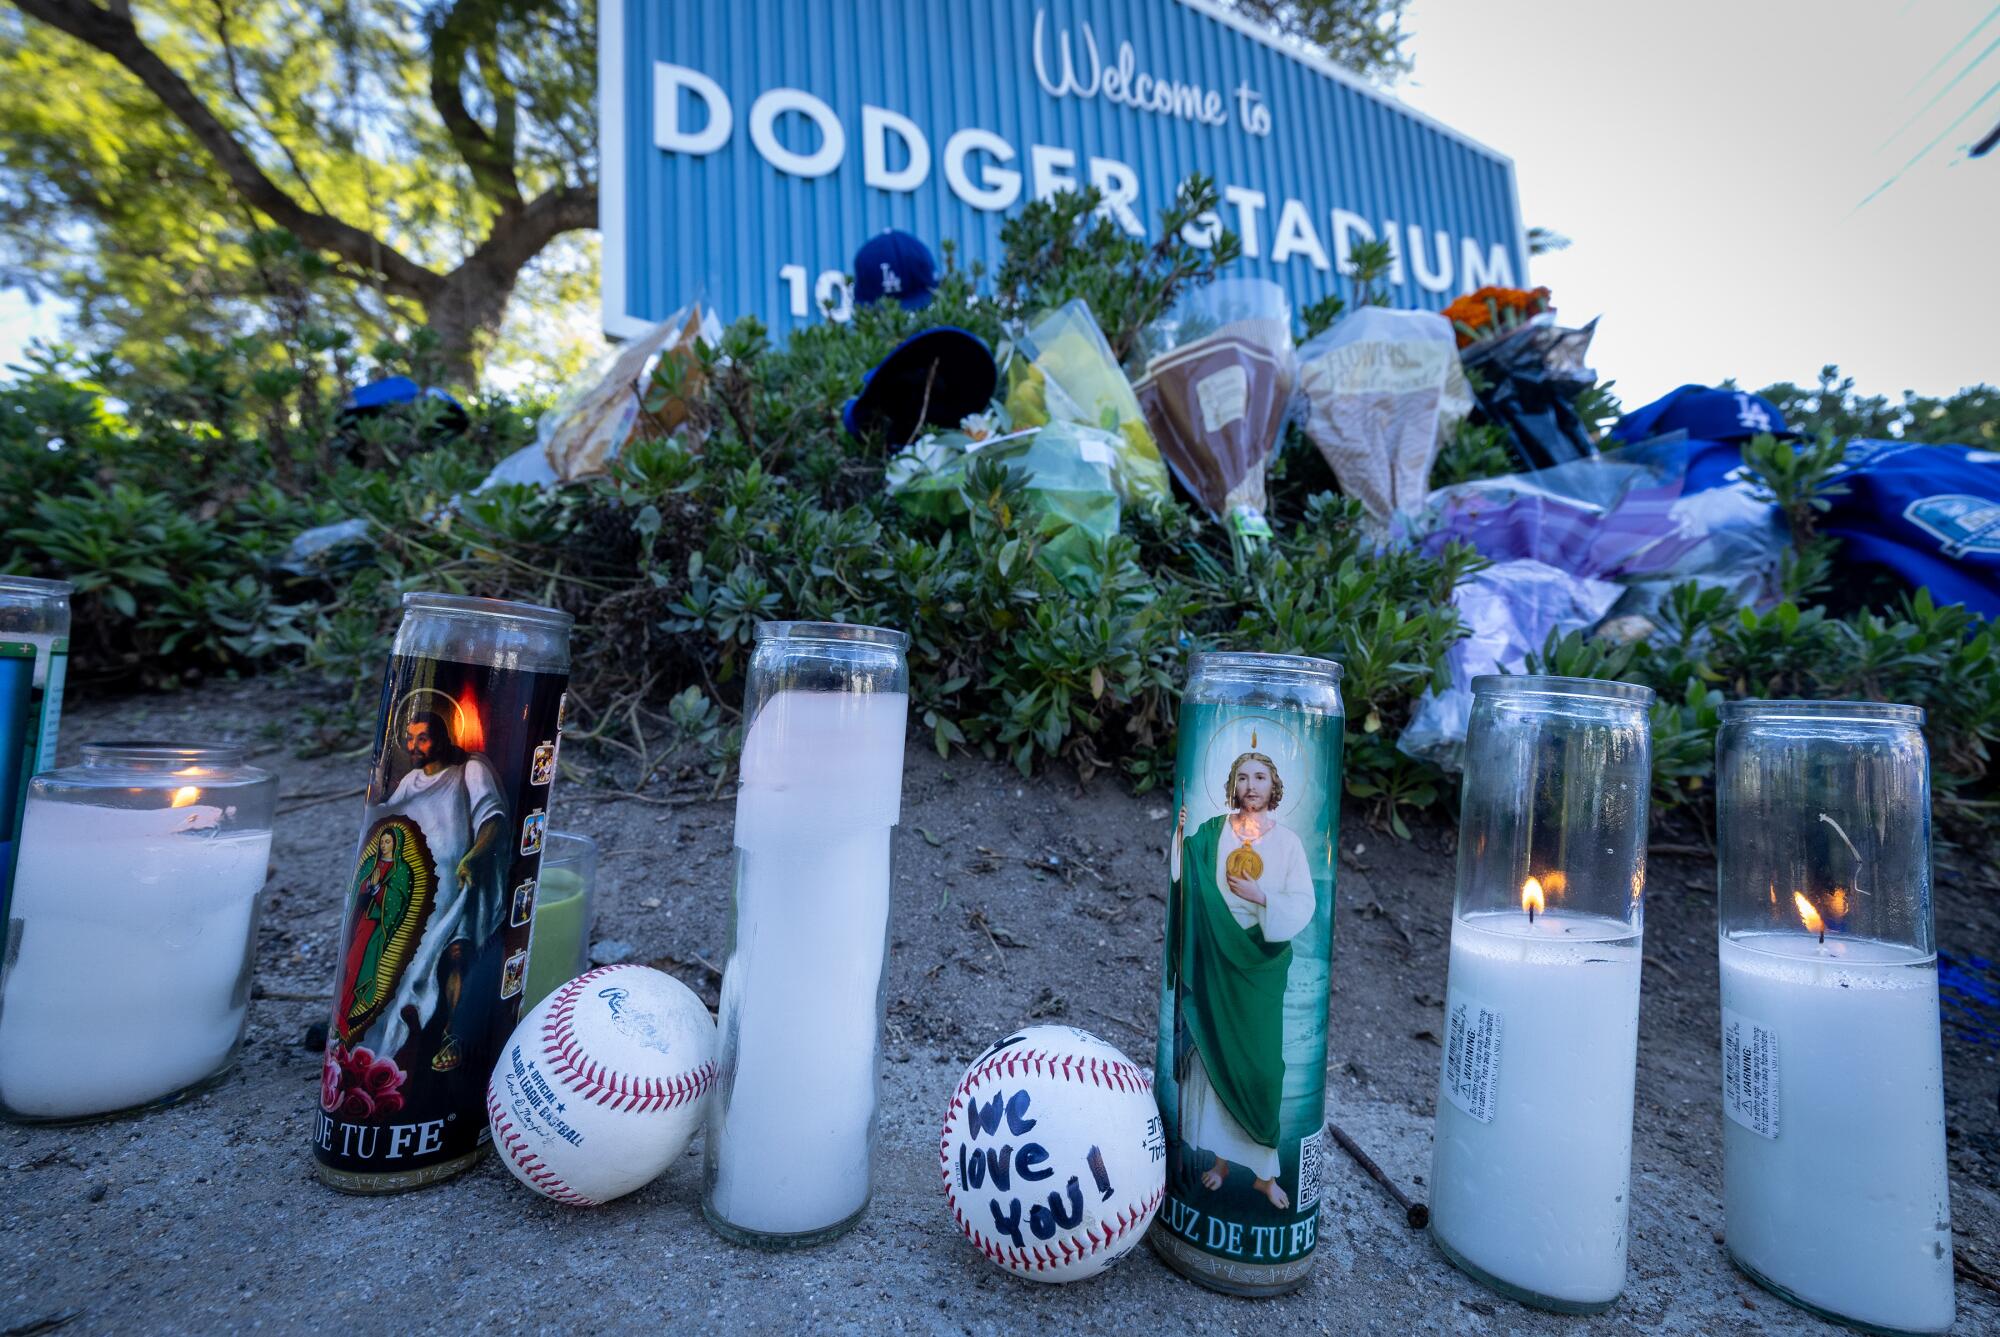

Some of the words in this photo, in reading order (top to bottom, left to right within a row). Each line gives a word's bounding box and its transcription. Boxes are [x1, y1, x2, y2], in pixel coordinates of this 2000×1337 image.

[1033, 8, 1227, 128] Welcome
[1234, 81, 1271, 137] to
[653, 60, 1146, 237] DODGER
[1177, 176, 1515, 292] STADIUM
[1464, 1027, 1476, 1080] WARNING:
[1743, 1045, 1751, 1096] WARNING:
[512, 1045, 526, 1079] MAJOR
[519, 1075, 545, 1110] LEAGUE
[539, 1106, 584, 1147] BASEBALL
[531, 1070, 557, 1105] OFFICIAL
[315, 1111, 334, 1151] DE
[339, 1123, 380, 1159] TU
[960, 1142, 1055, 1192] love
[1160, 1196, 1200, 1241] LUZ
[1206, 1216, 1243, 1254] DE
[1251, 1226, 1286, 1258] TU
